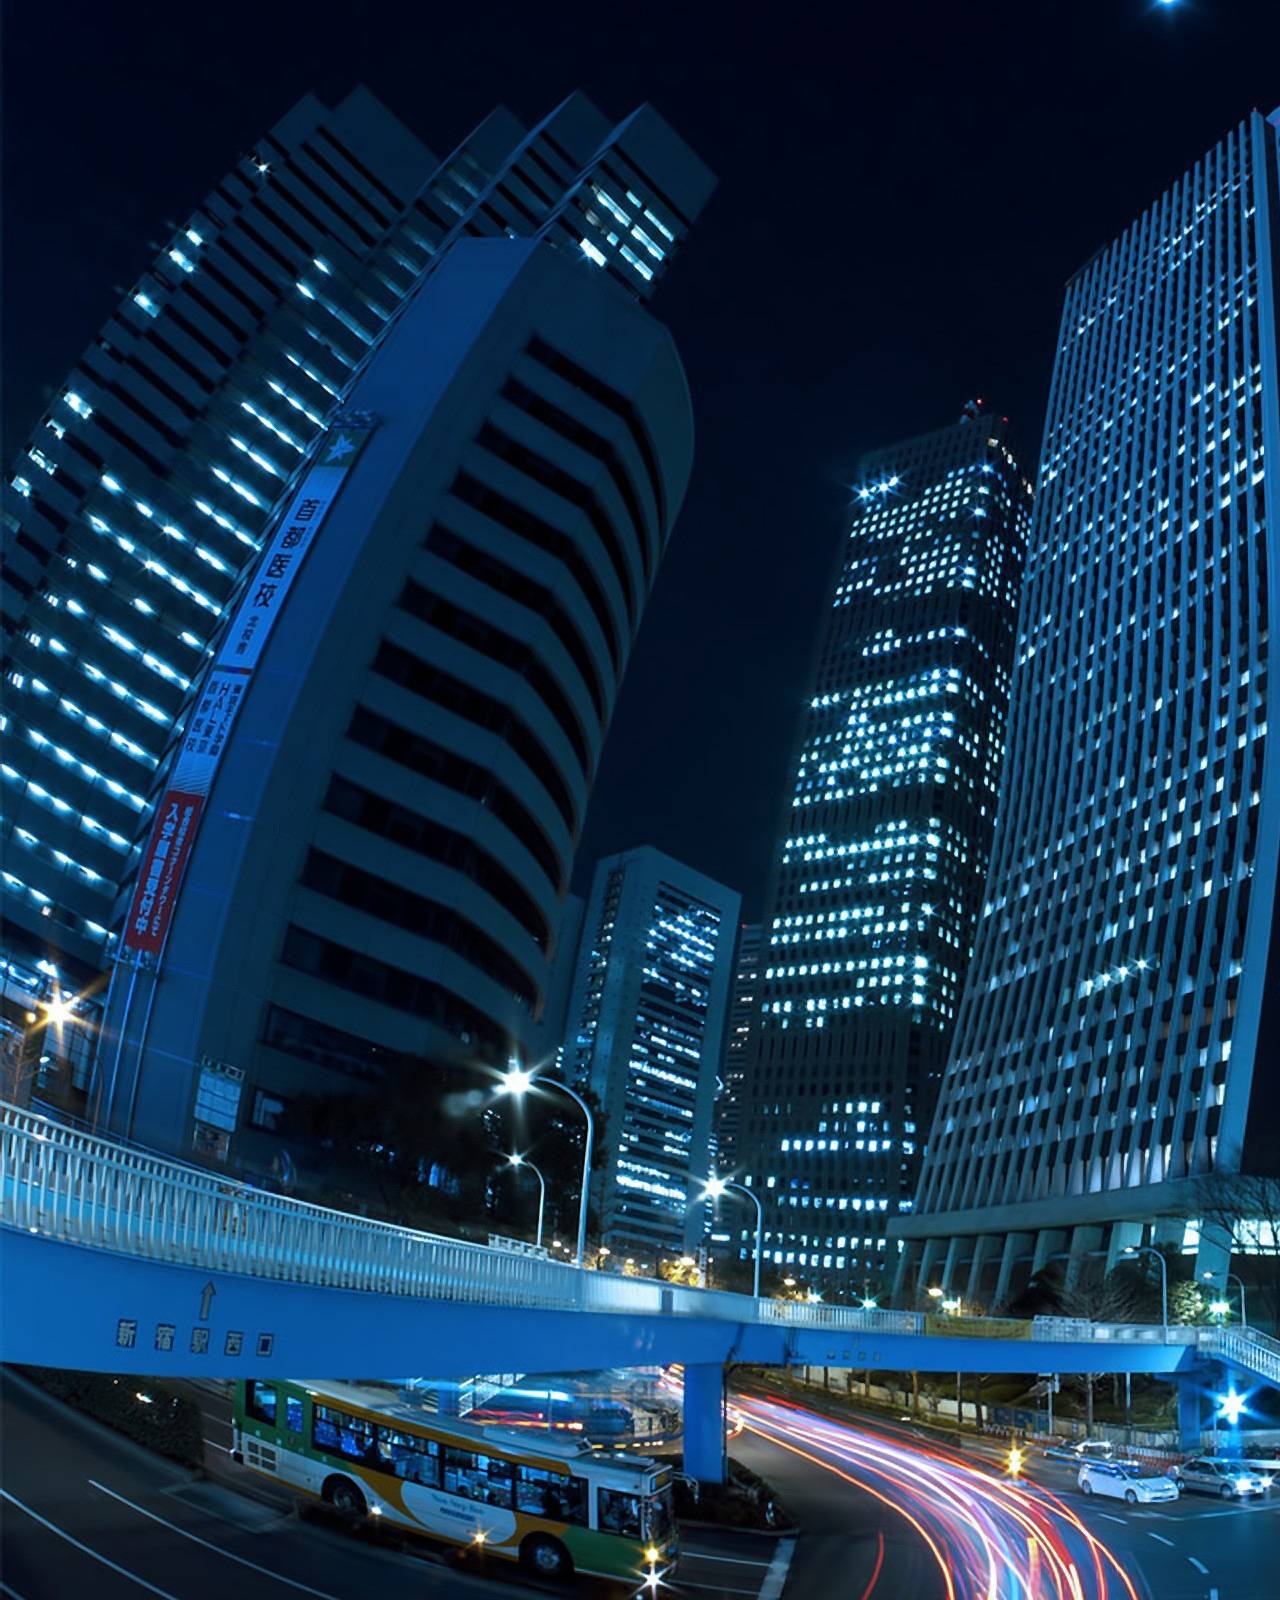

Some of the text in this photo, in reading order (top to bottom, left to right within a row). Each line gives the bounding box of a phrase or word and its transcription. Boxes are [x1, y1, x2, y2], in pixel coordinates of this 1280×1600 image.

[116, 1320, 273, 1356] 新宿駅西口
